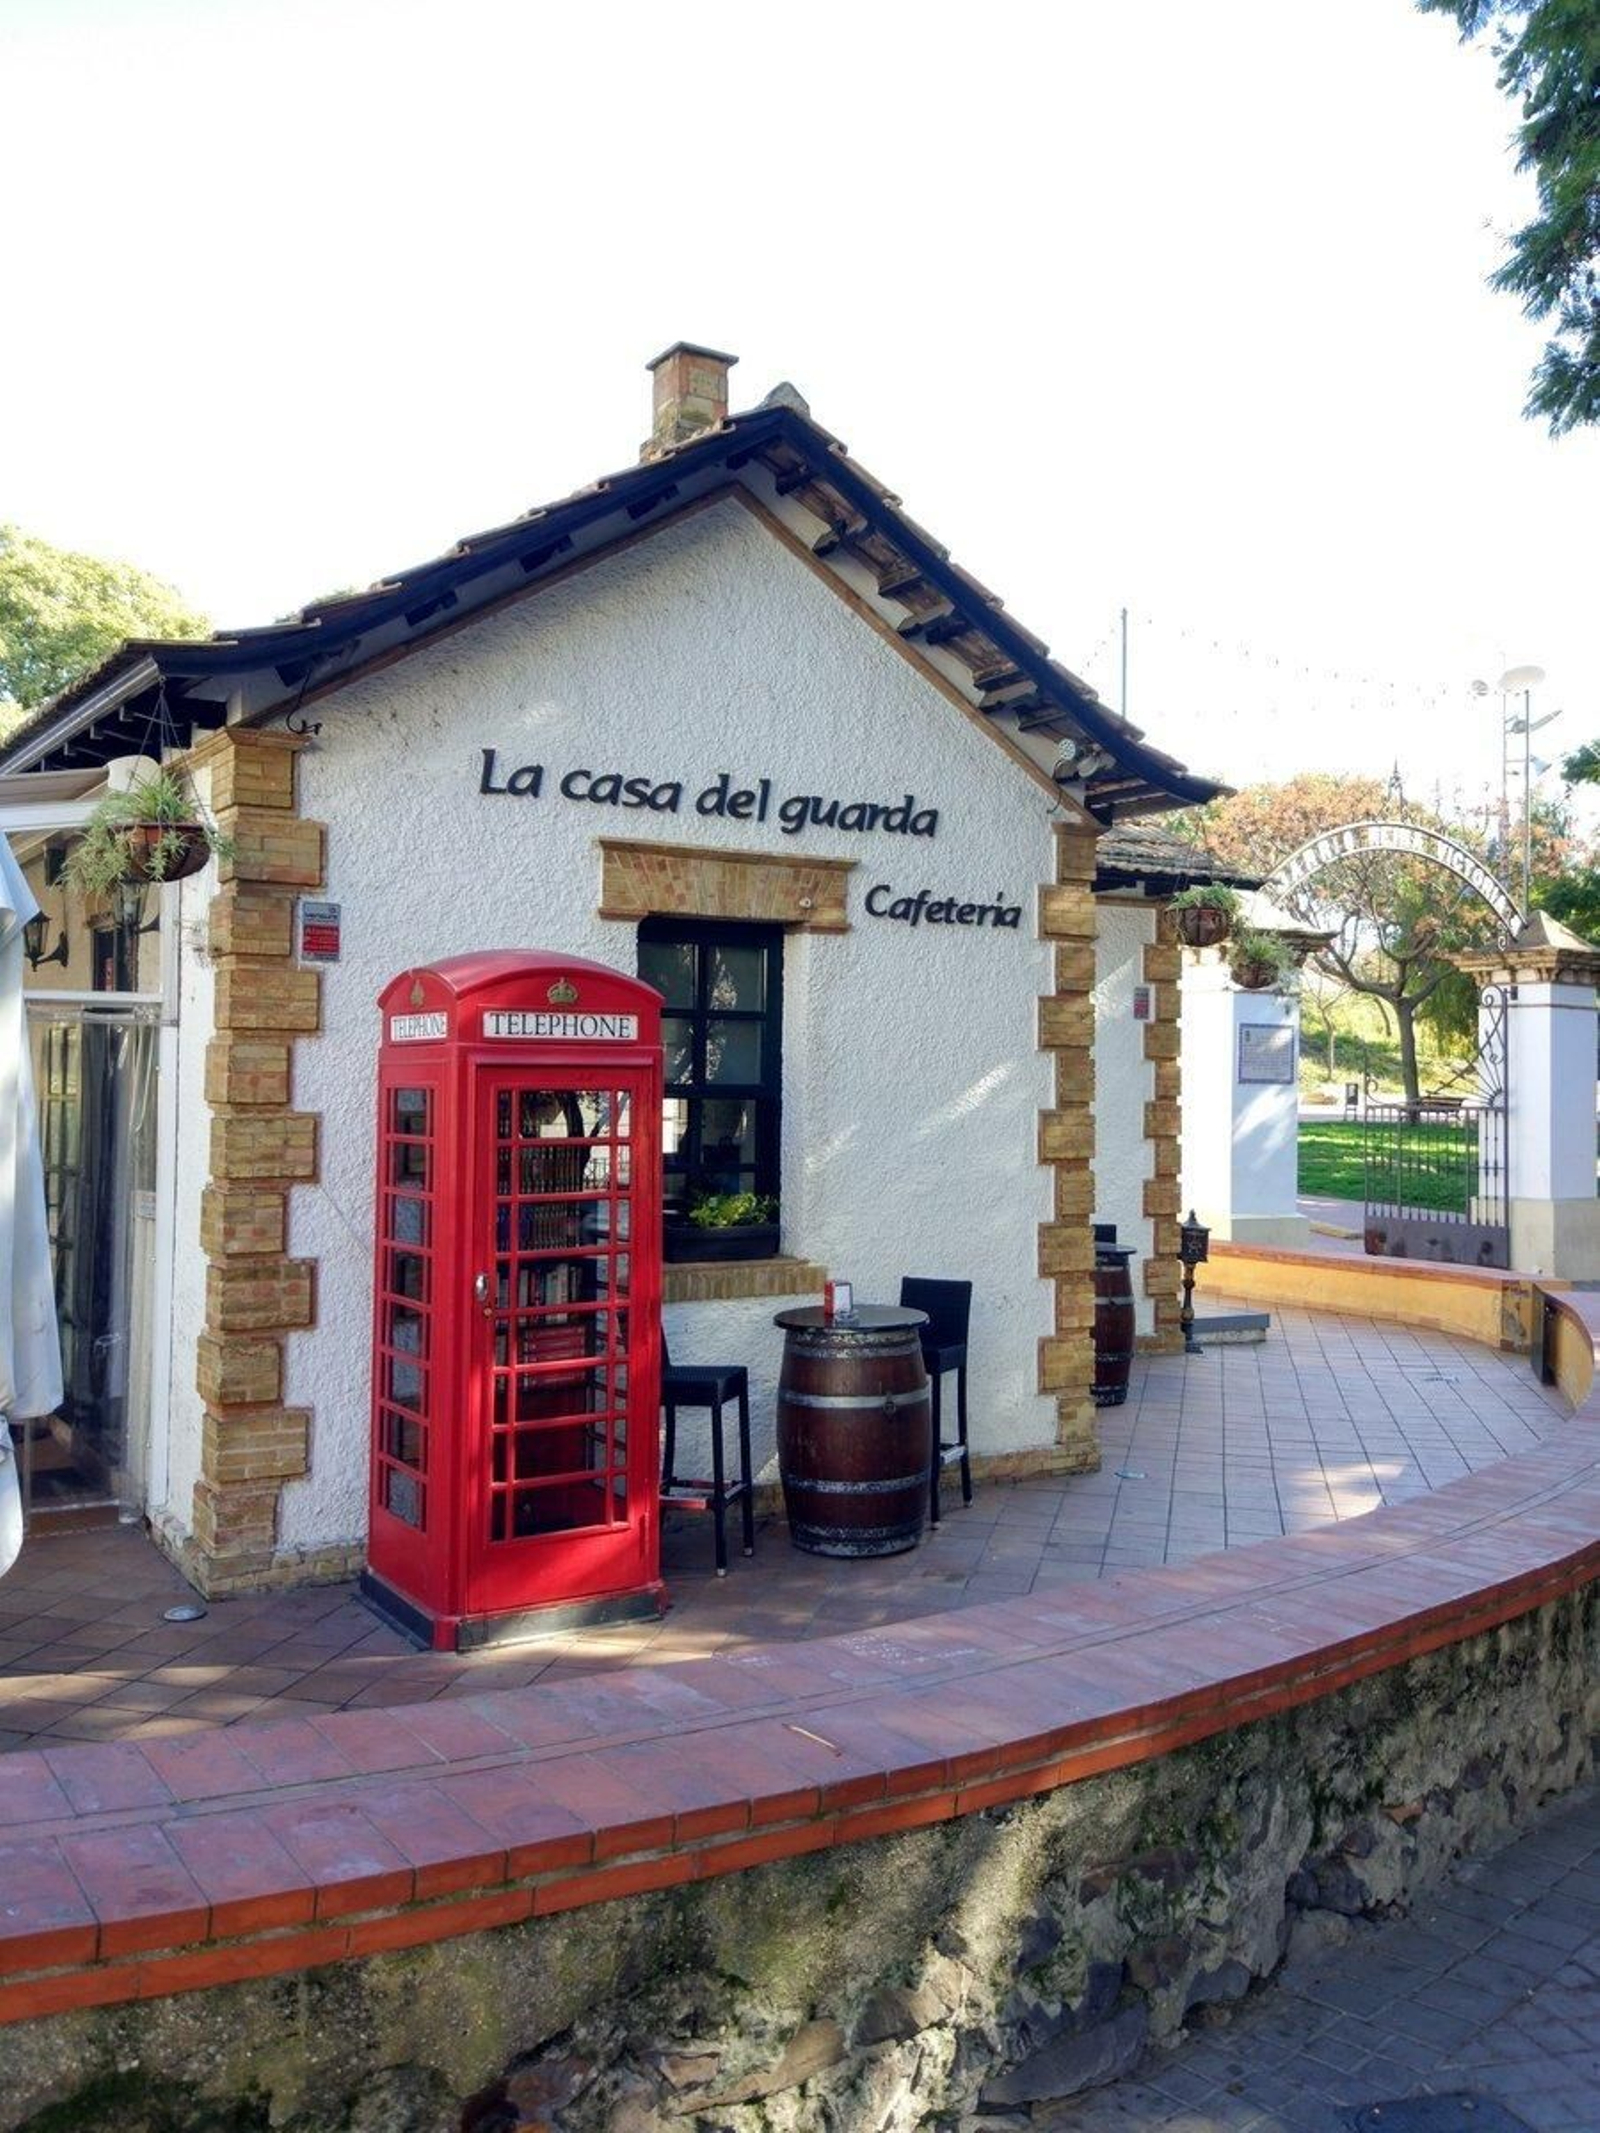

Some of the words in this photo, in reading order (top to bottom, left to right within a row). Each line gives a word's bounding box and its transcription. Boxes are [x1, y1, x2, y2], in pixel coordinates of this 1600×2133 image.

[479, 748, 544, 799] La
[559, 766, 682, 815] casa
[695, 773, 772, 823] del
[777, 794, 939, 838] guarda
[1434, 840, 1509, 916] VICTORIA
[864, 883, 1022, 929] Cafetería
[393, 1013, 445, 1039] TELEPHONE
[490, 1012, 631, 1038] TELEPHONE
